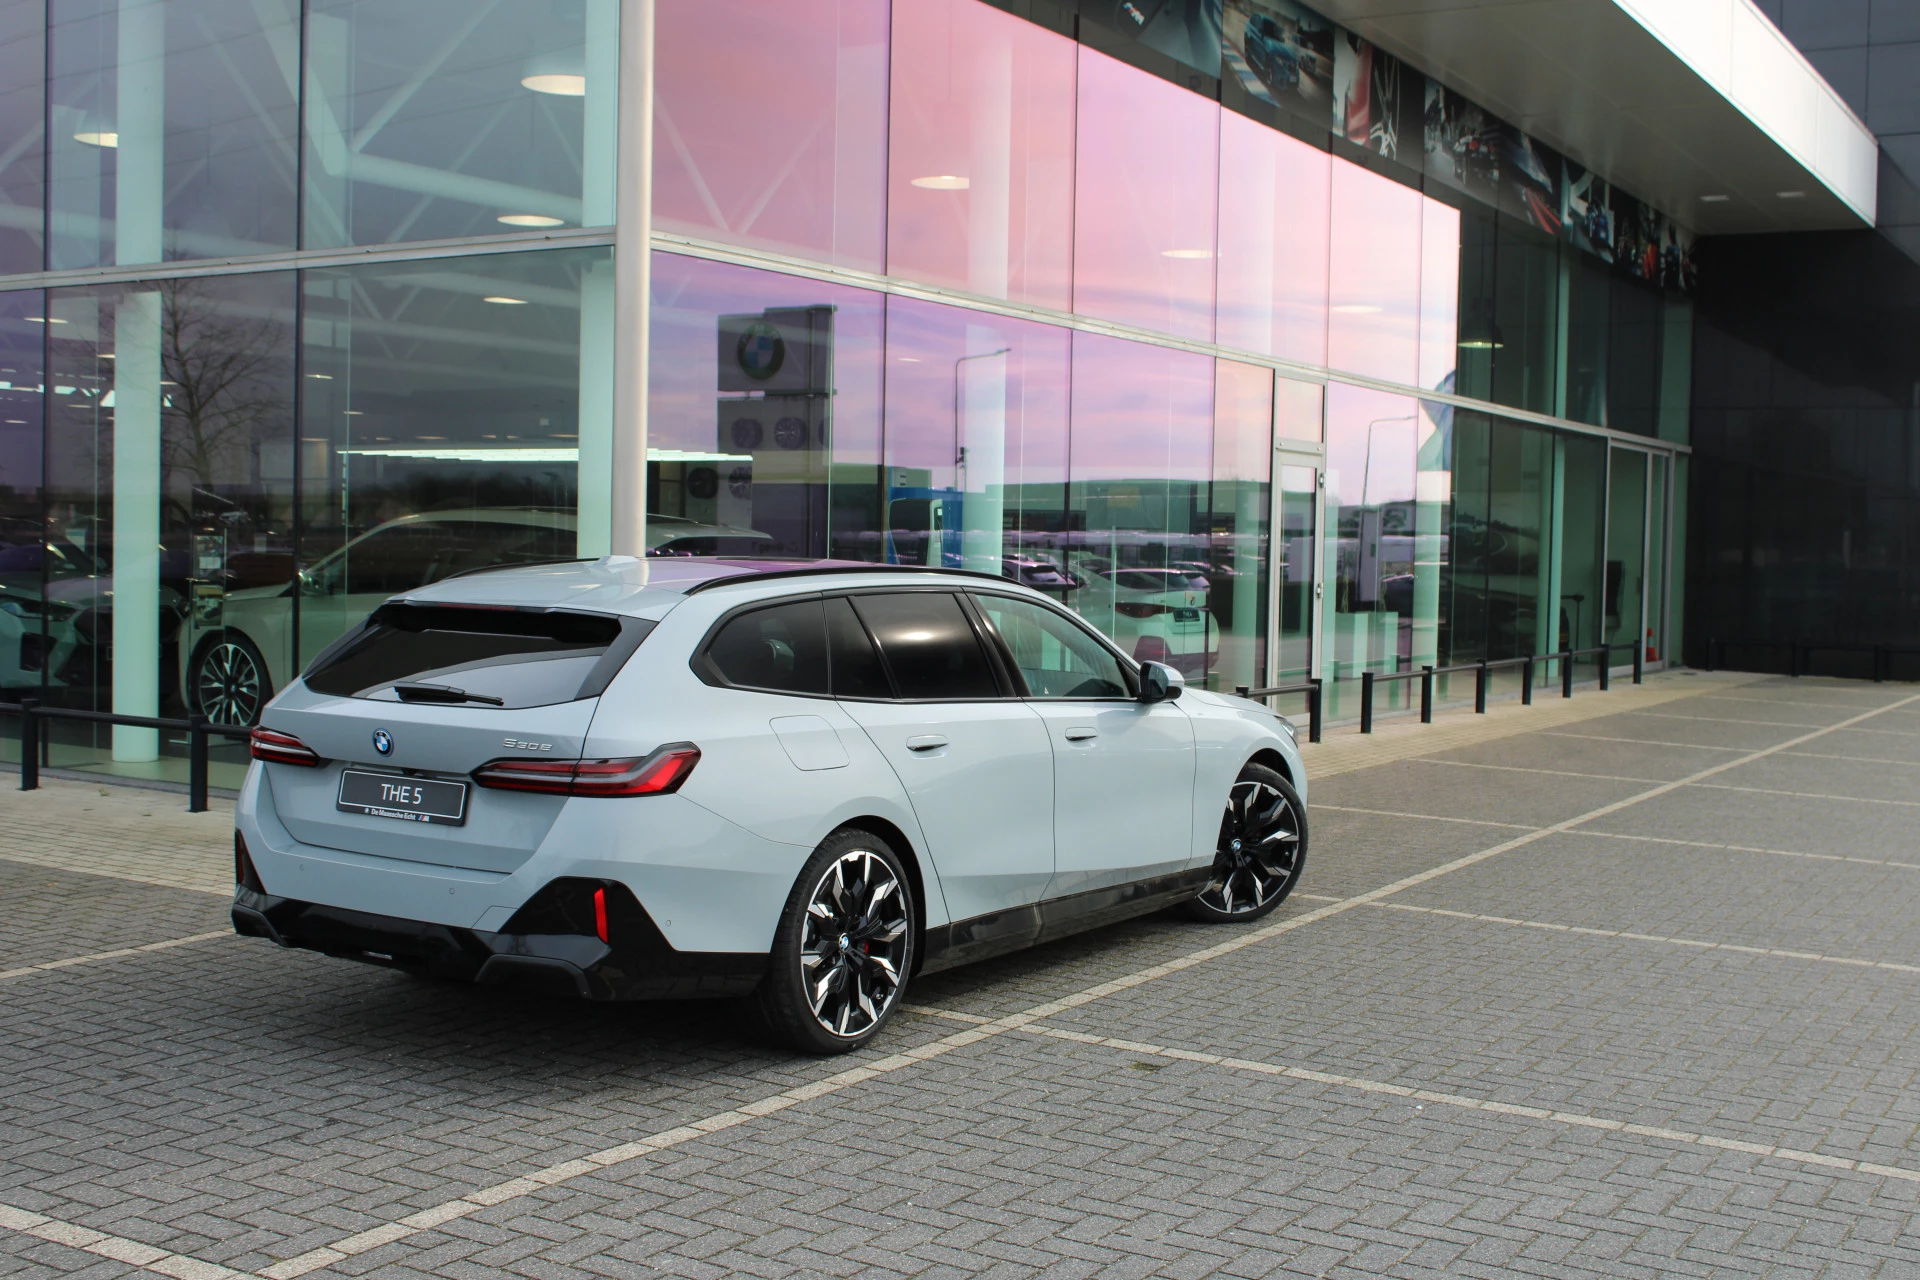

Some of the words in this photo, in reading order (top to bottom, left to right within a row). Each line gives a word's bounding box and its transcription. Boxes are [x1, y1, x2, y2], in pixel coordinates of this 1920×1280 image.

[381, 783, 411, 803] THE
[412, 787, 423, 805] 5
[371, 808, 379, 816] De
